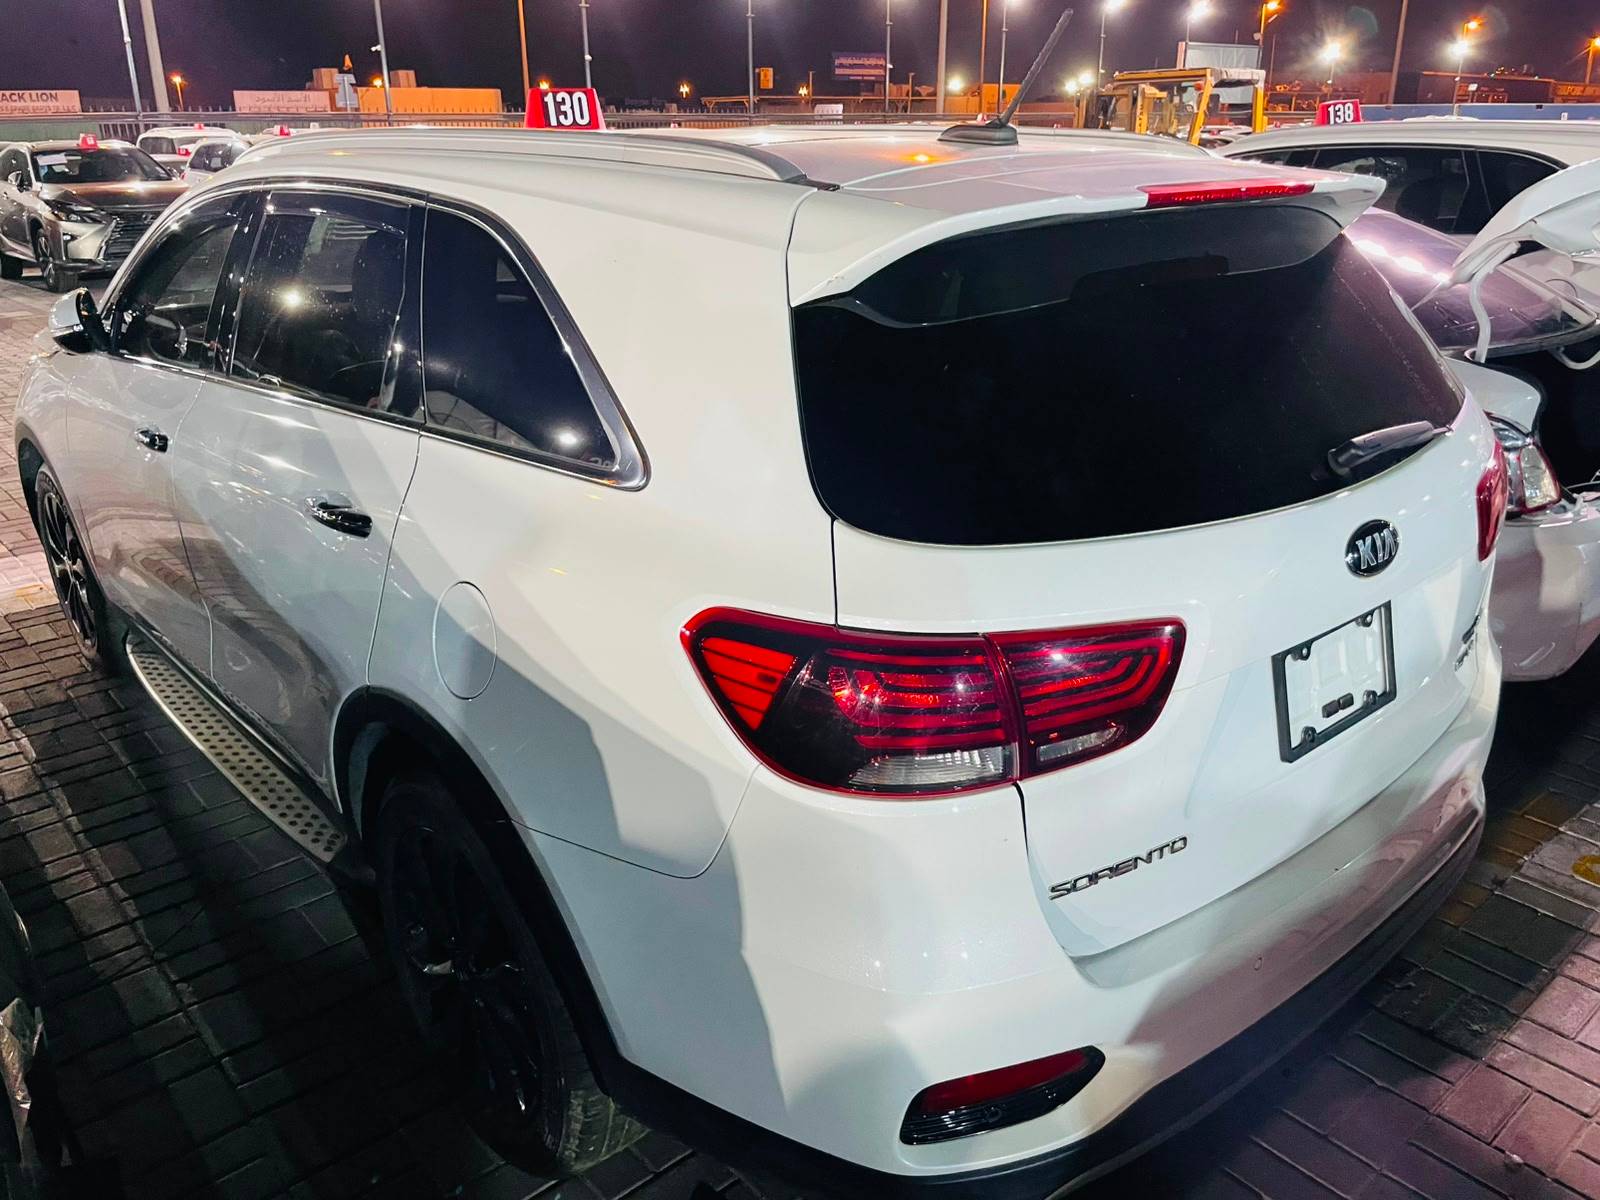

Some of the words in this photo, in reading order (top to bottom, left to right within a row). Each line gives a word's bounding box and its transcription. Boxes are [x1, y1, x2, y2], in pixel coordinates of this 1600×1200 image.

[29, 91, 59, 102] LION
[543, 91, 590, 126] 130
[1328, 102, 1354, 125] 138
[1355, 528, 1396, 569] KIA
[1048, 835, 1189, 901] SORENTO
